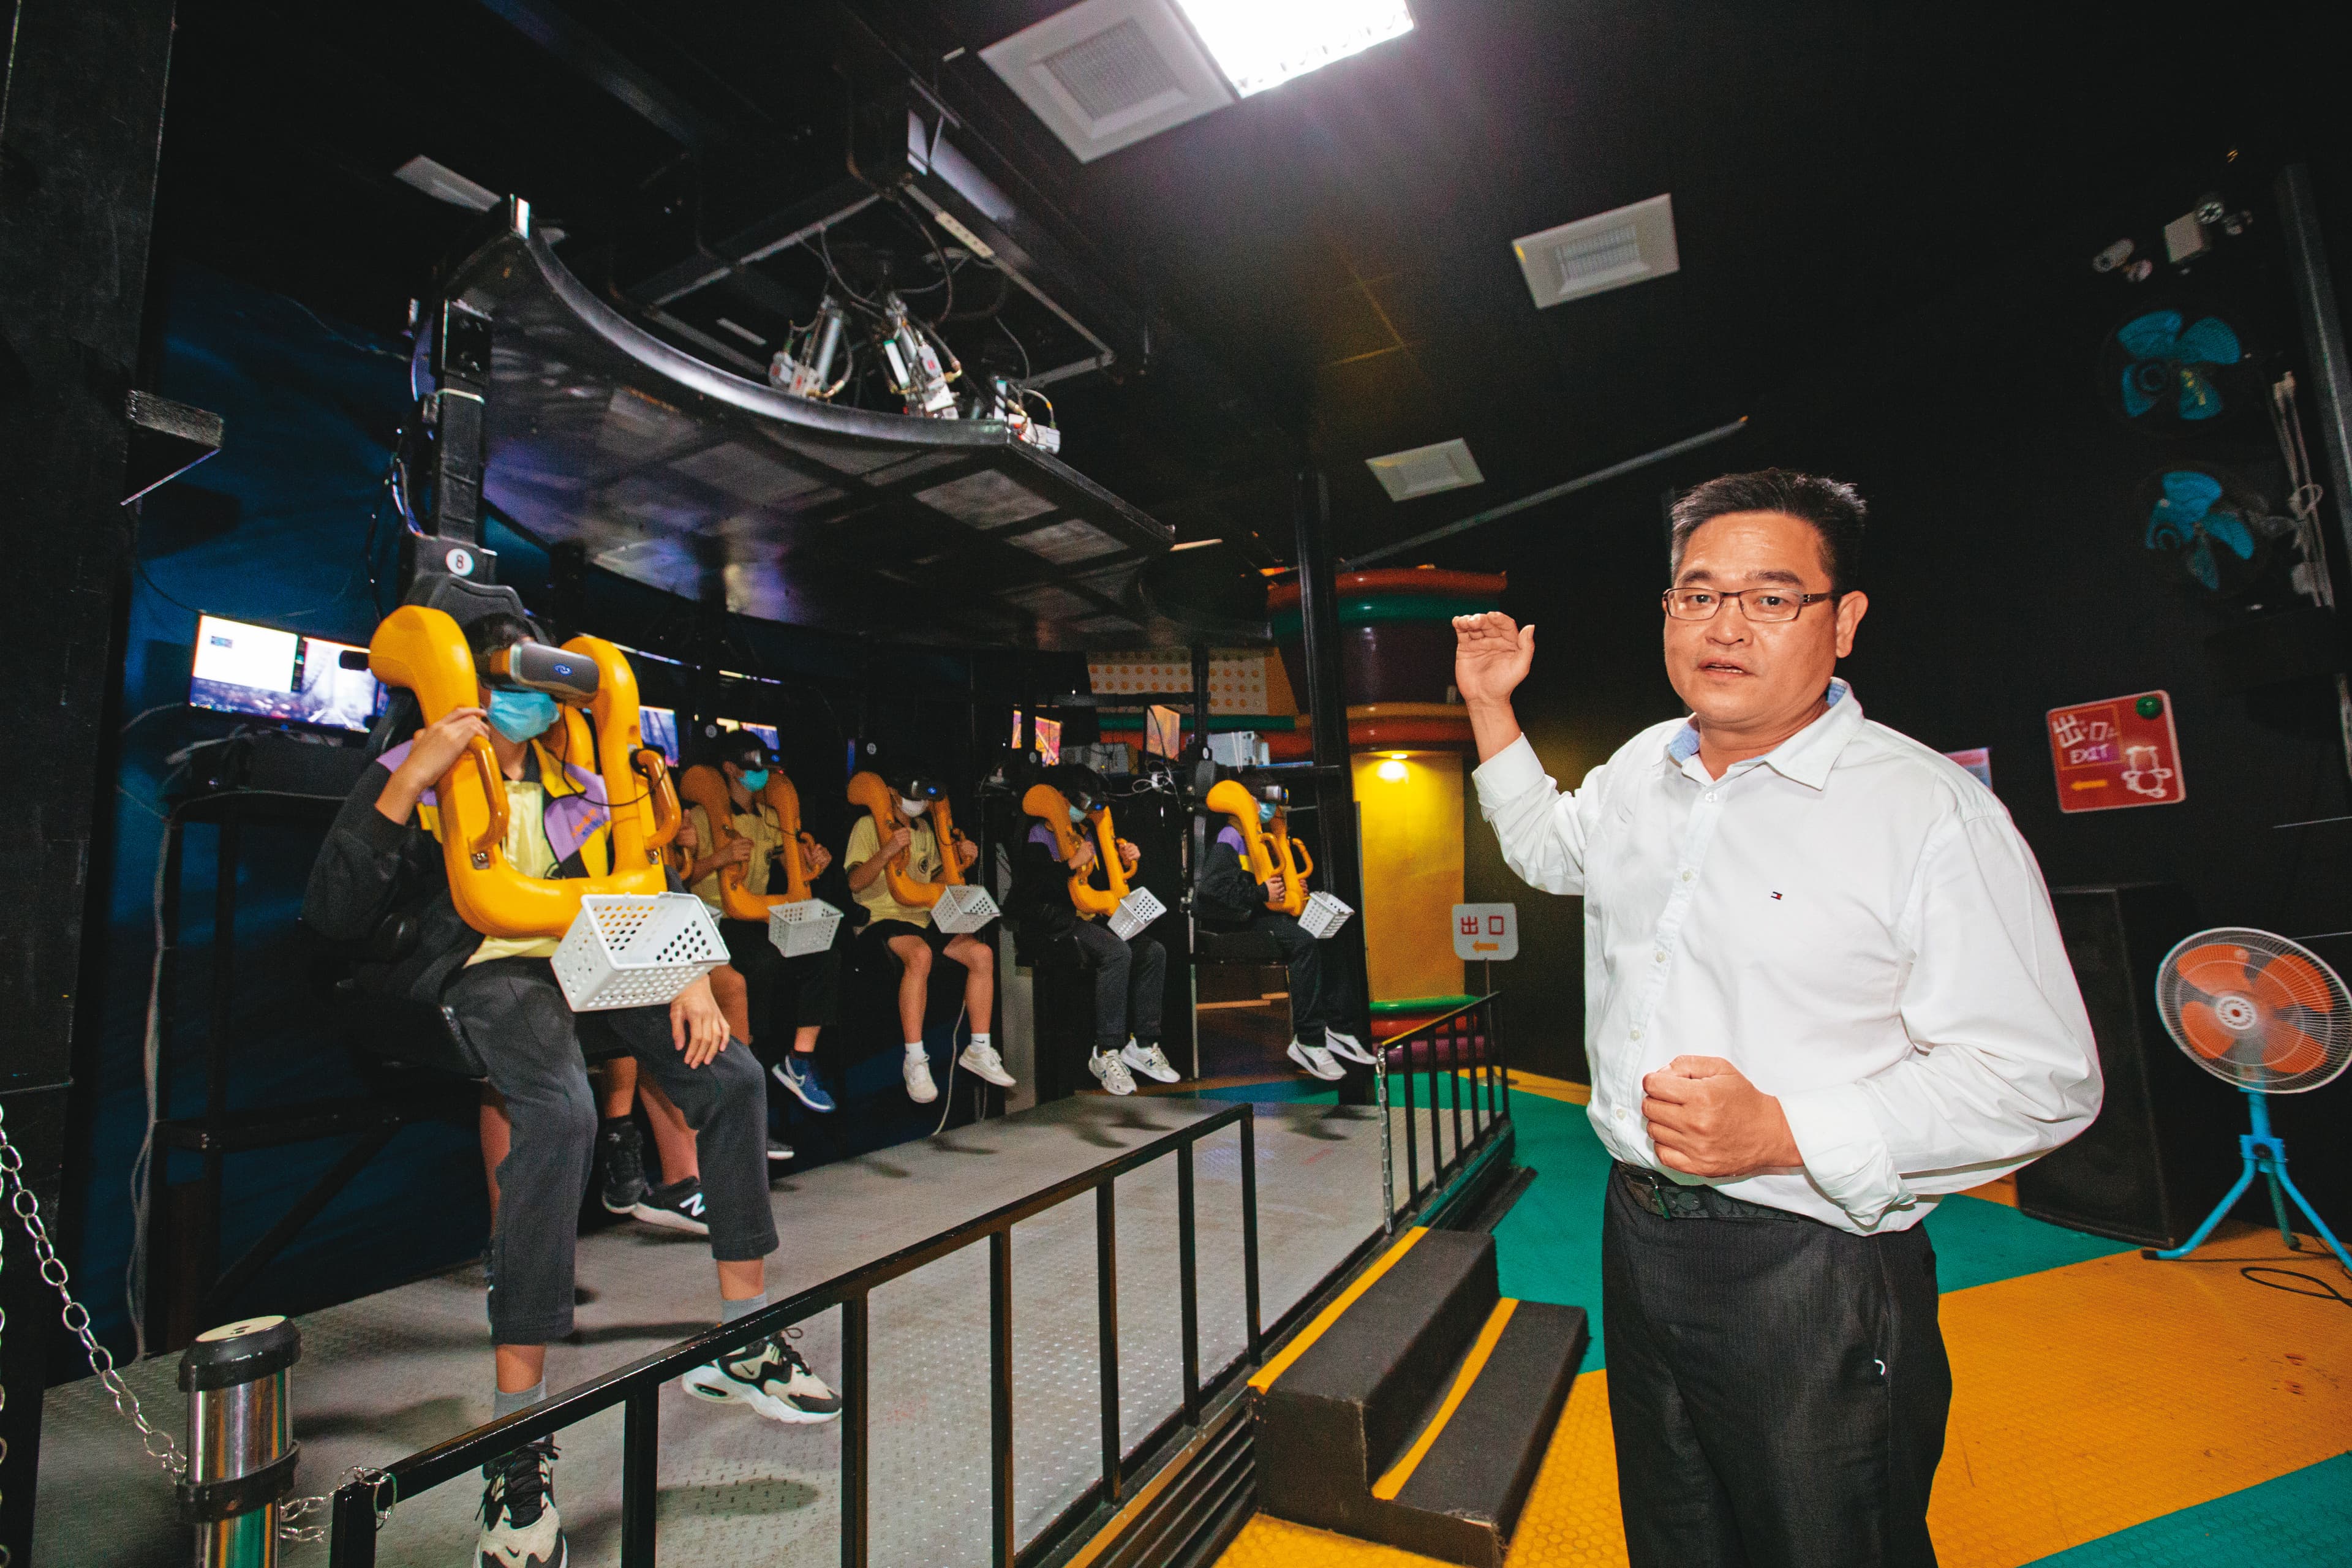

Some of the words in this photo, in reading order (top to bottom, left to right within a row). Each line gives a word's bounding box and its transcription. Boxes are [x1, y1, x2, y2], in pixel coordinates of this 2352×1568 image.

[456, 554, 464, 569] 8
[2052, 714, 2109, 748] 出口
[1460, 915, 1504, 936] 出口
